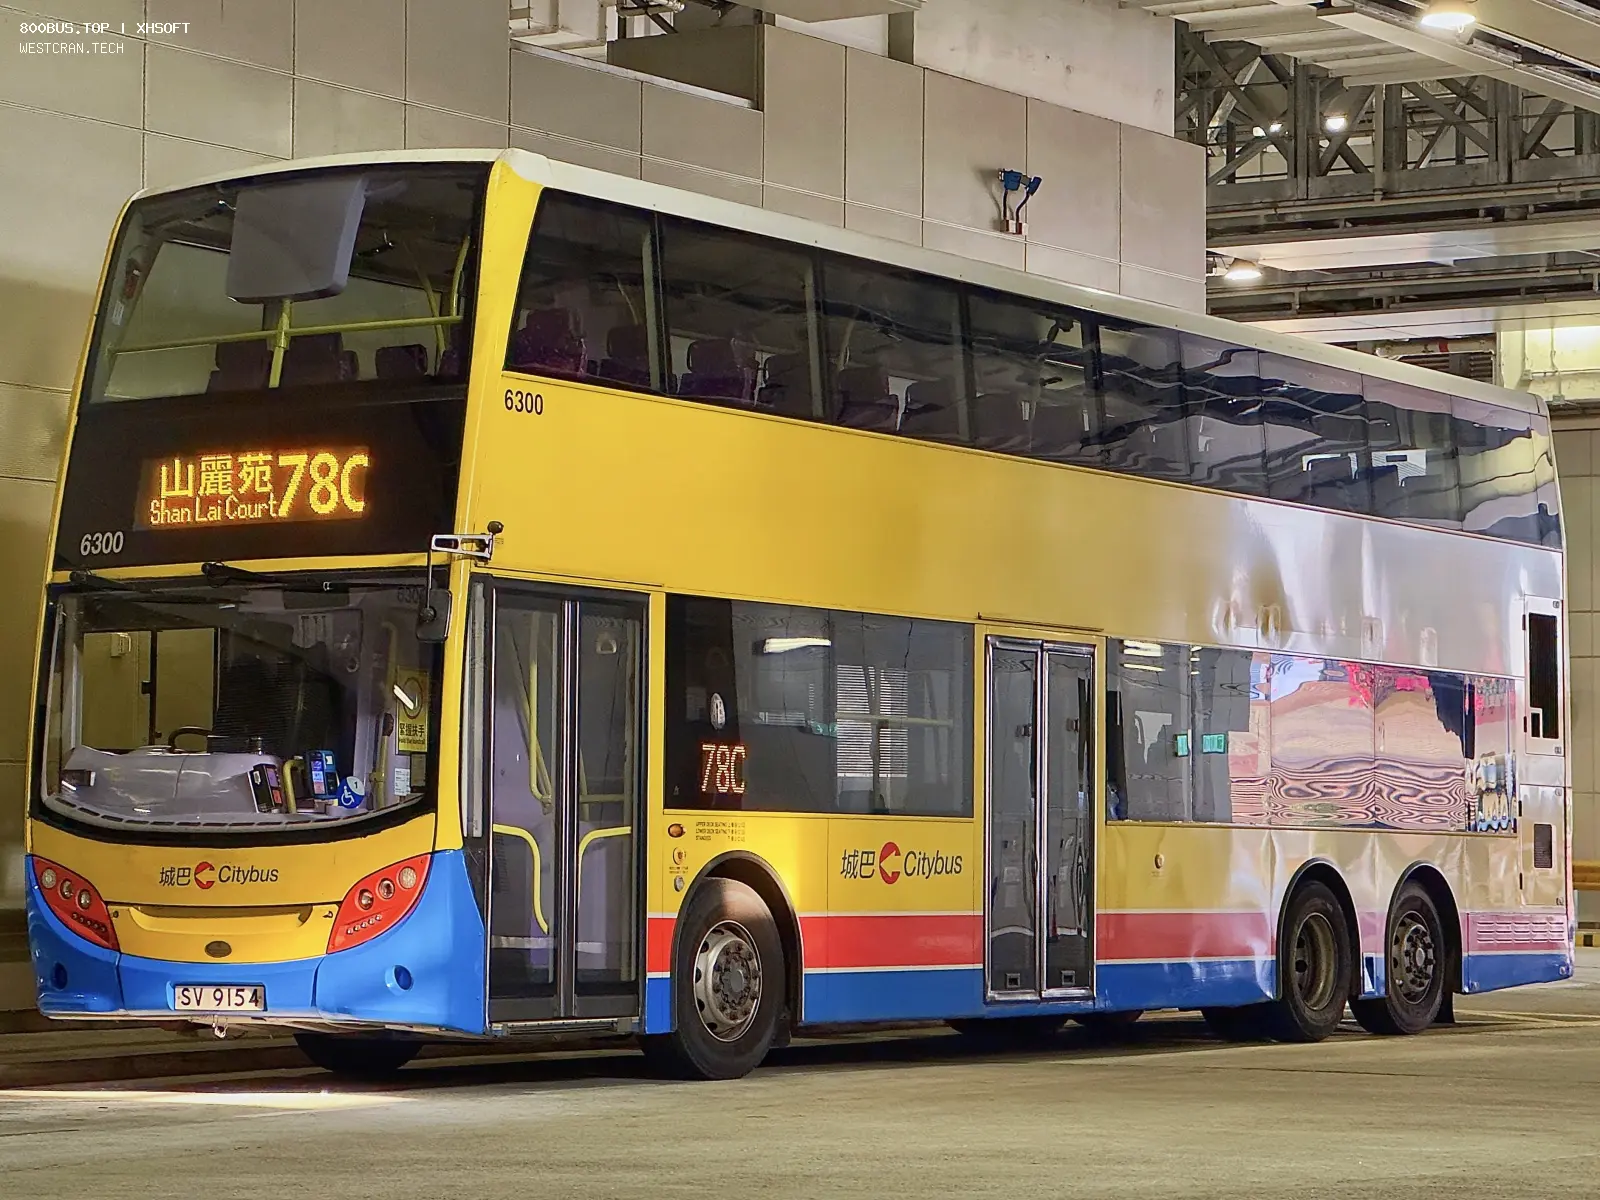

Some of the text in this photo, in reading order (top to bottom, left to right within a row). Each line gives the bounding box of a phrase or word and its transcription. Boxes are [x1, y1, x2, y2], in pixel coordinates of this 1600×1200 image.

[504, 388, 544, 416] 6300
[161, 452, 273, 498] 山麗苑
[278, 452, 369, 518] 78C
[150, 491, 278, 524] Shan Lai Court
[80, 530, 124, 556] 6300
[701, 743, 746, 793] 78C
[159, 866, 192, 887] 城巴
[218, 865, 279, 885] Citybus
[840, 848, 876, 879] 城巴
[903, 849, 963, 880] Citybus
[181, 987, 260, 1007] SV 9154
